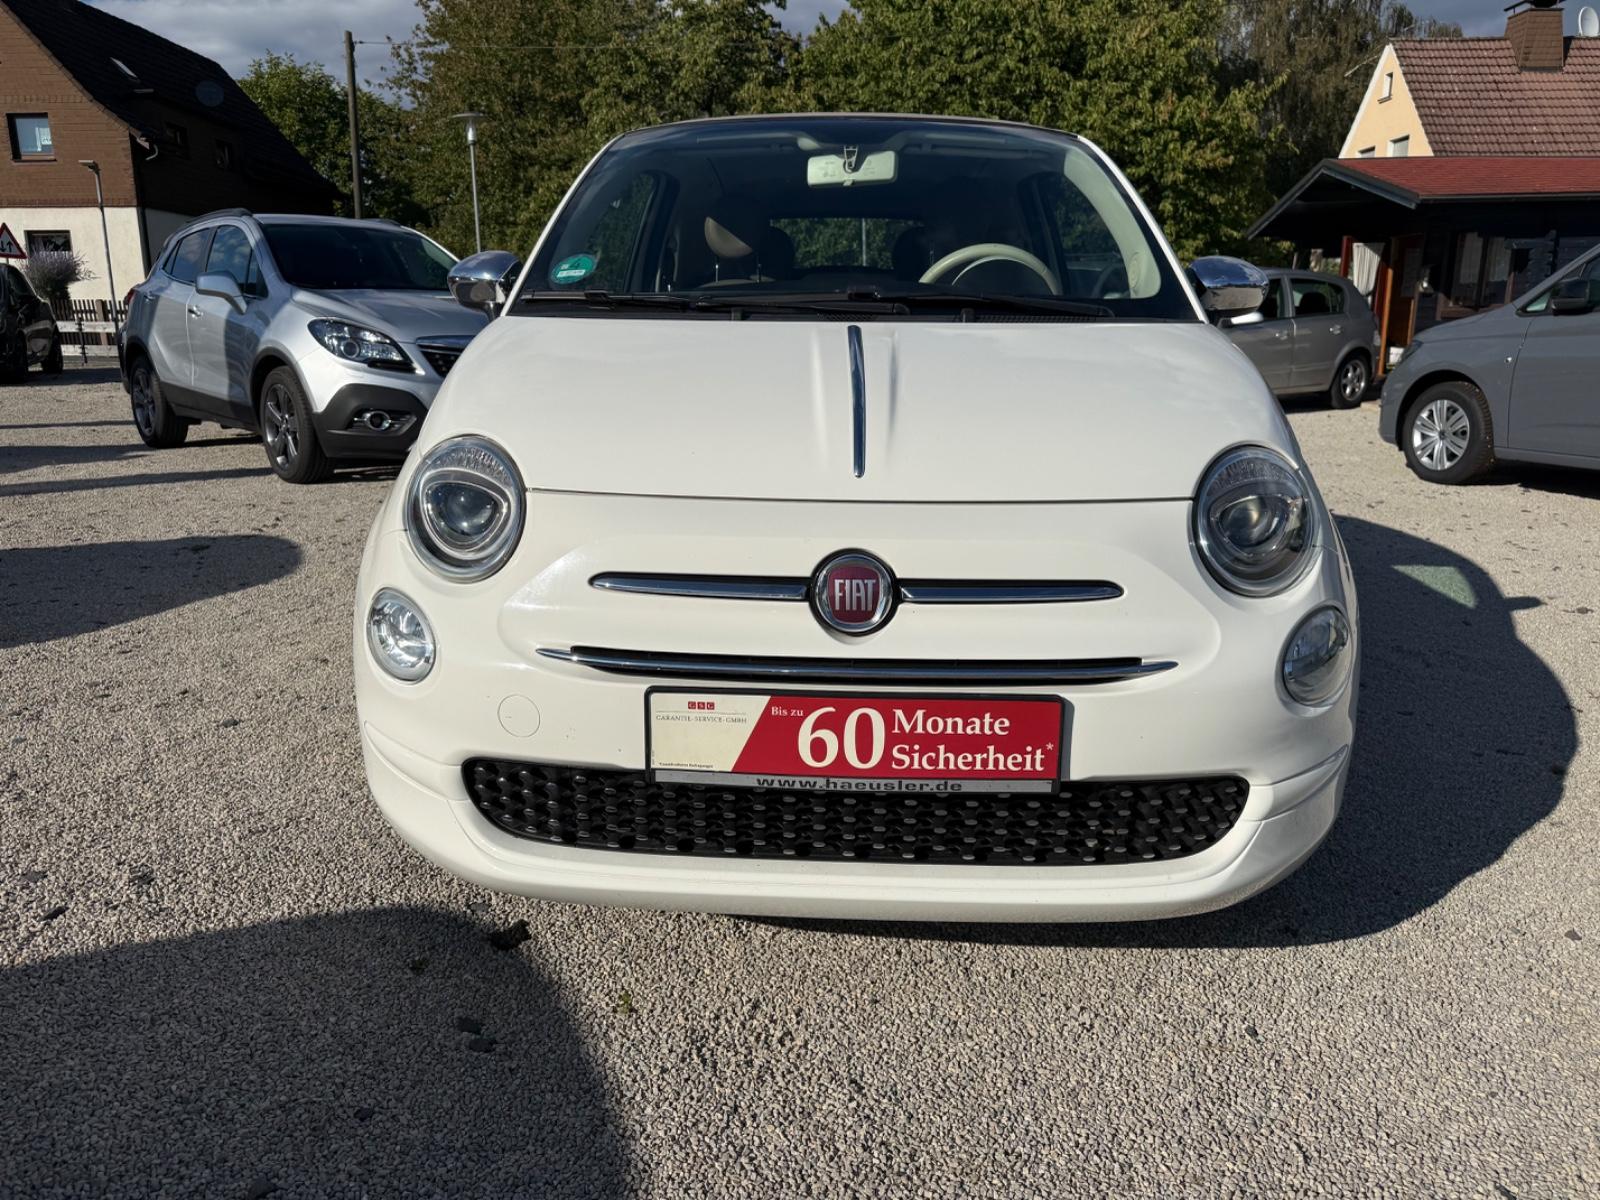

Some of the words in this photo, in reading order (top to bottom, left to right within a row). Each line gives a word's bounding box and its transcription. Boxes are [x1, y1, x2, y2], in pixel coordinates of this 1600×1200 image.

[834, 579, 876, 611] FIAT
[771, 706, 787, 716] Bis
[790, 709, 804, 717] zu
[891, 708, 1010, 735] Monate
[798, 706, 885, 769] 60
[756, 777, 962, 791] www.haeusler.de
